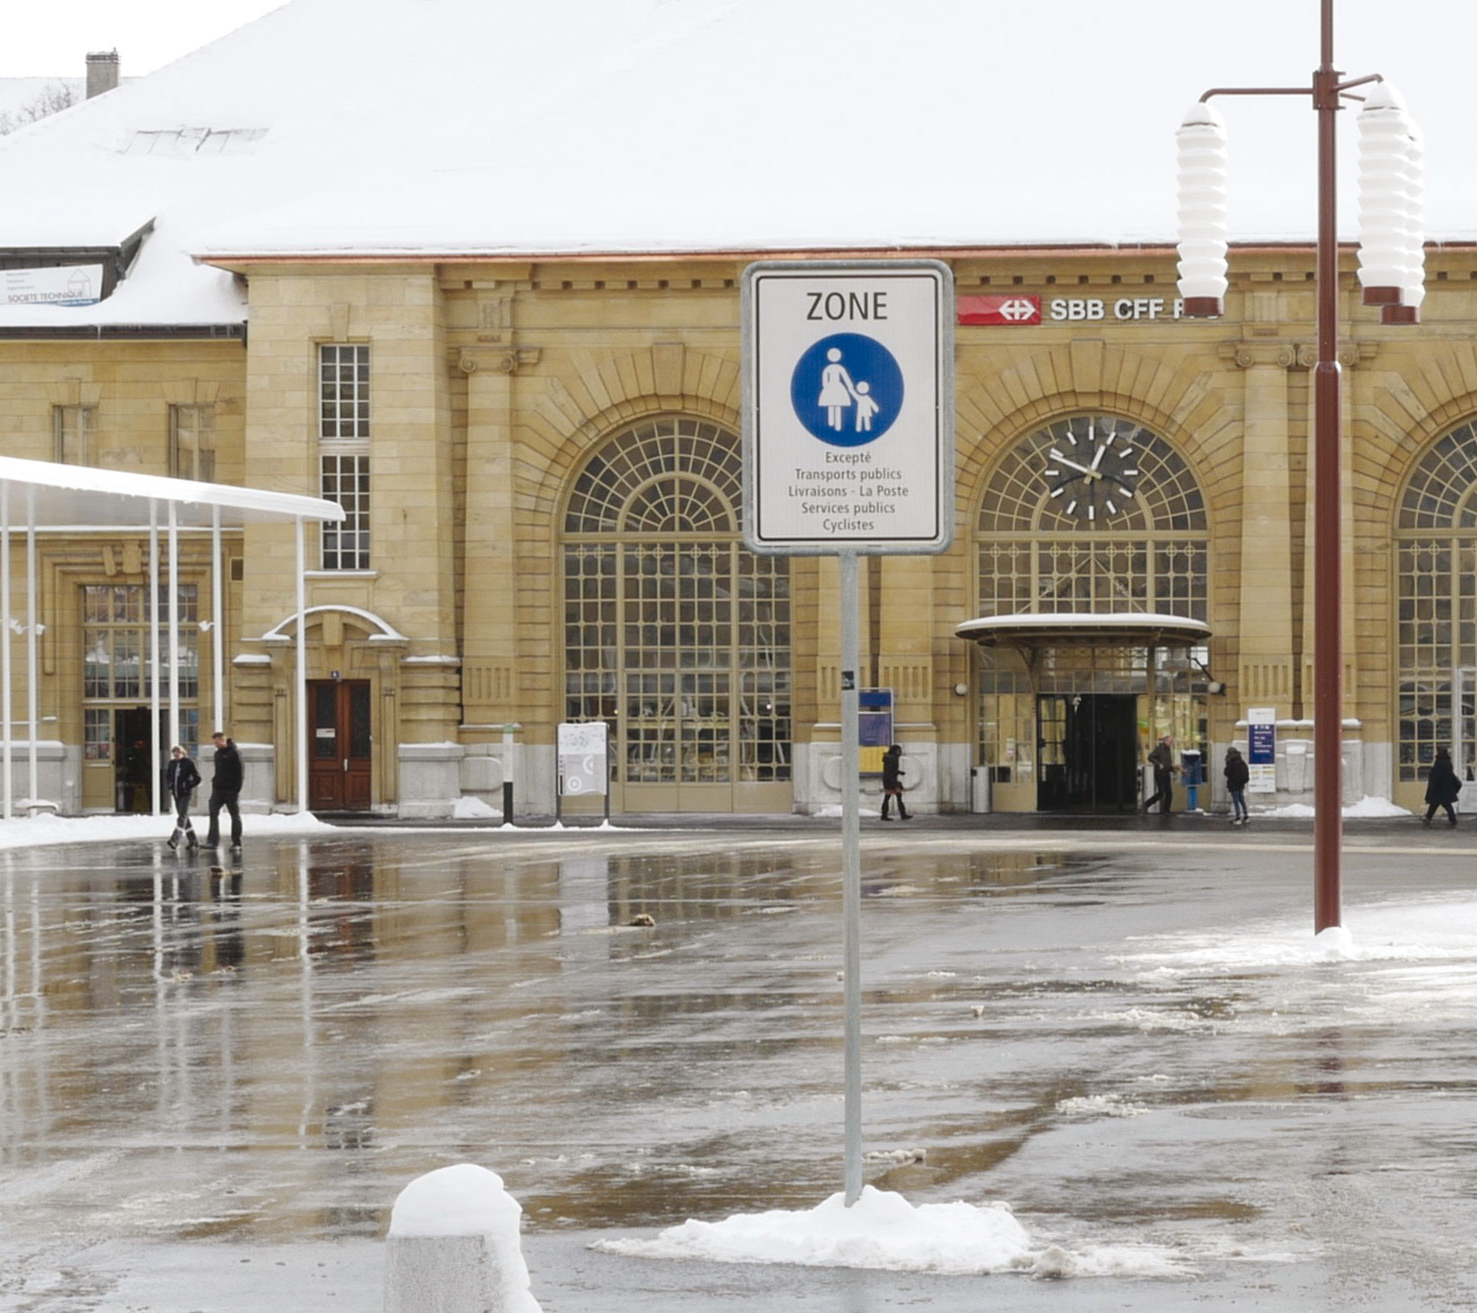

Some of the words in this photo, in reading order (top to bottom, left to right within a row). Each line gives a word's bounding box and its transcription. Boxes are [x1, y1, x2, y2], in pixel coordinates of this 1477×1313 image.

[806, 292, 887, 320] ZONE
[1050, 299, 1105, 321] SBB
[1114, 299, 1164, 320] CFF
[825, 451, 871, 466] Excepté
[795, 468, 856, 483] Transports
[860, 468, 902, 483] publics
[788, 485, 847, 497] Livraisons
[859, 485, 872, 497] La
[877, 485, 909, 497] Poste
[801, 502, 850, 514] Services
[853, 502, 896, 517] publics
[822, 519, 874, 534] Cyclistes
